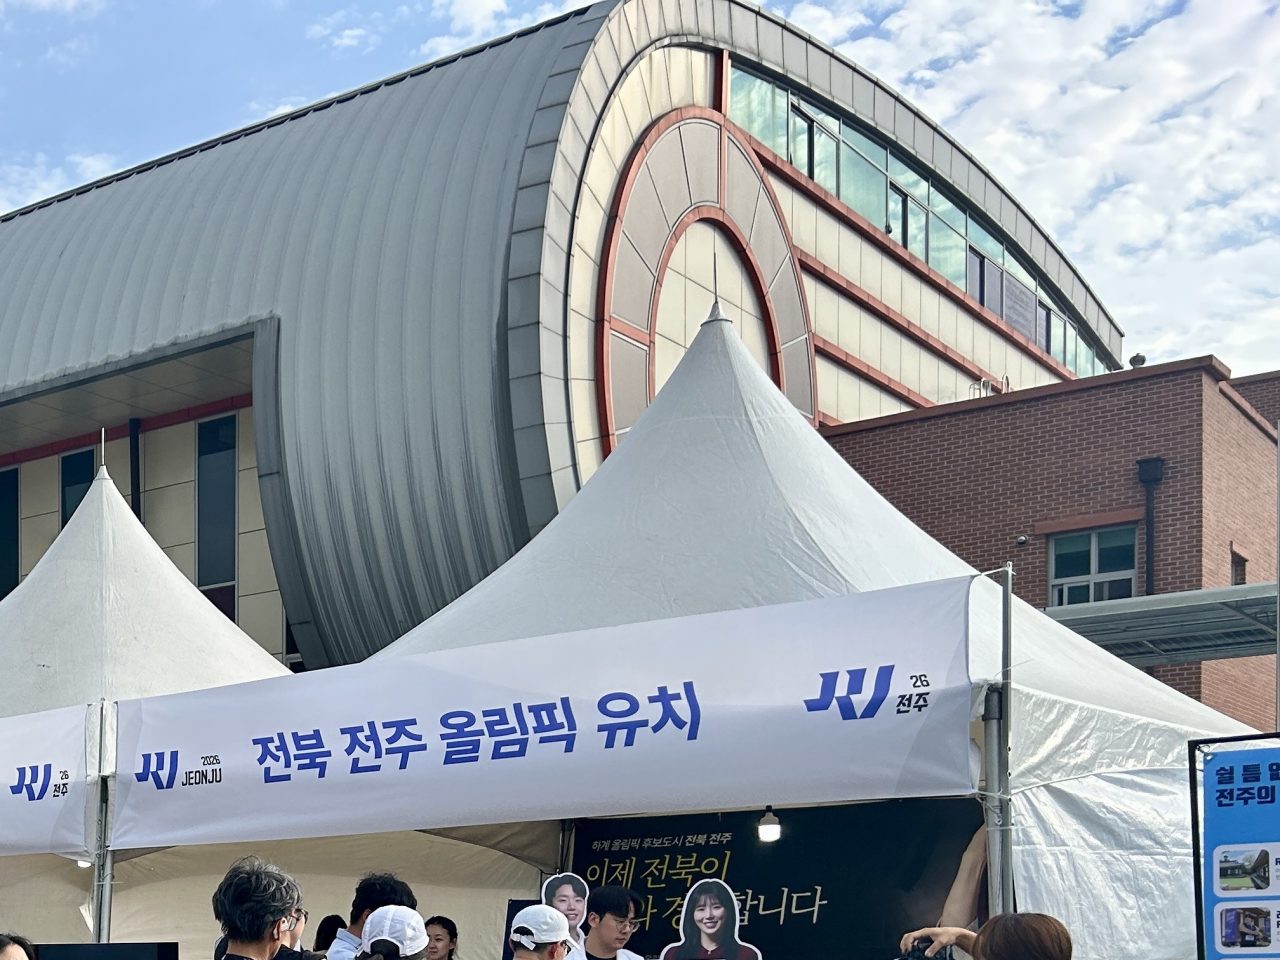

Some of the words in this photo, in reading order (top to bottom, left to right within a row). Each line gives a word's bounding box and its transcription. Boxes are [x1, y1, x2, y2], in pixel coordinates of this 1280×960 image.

[910, 674, 929, 688] 26
[896, 692, 930, 714] 전주
[252, 729, 332, 784] 전북
[340, 718, 428, 774] 전주
[439, 696, 578, 766] 올림픽
[597, 681, 702, 749] 유치
[201, 755, 220, 766] 2026
[181, 768, 222, 786] JEONJU
[1215, 766, 1235, 785] 쉴
[1241, 764, 1262, 783] 틈
[53, 783, 68, 798] 전주
[1215, 785, 1276, 807] 전주의
[592, 840, 609, 851] 하계
[611, 838, 640, 850] 올림픽
[641, 836, 683, 849] 후보도시
[685, 834, 707, 846] 전북
[709, 832, 733, 844] 전주
[586, 857, 637, 887] 이제
[640, 850, 732, 888] 전북이
